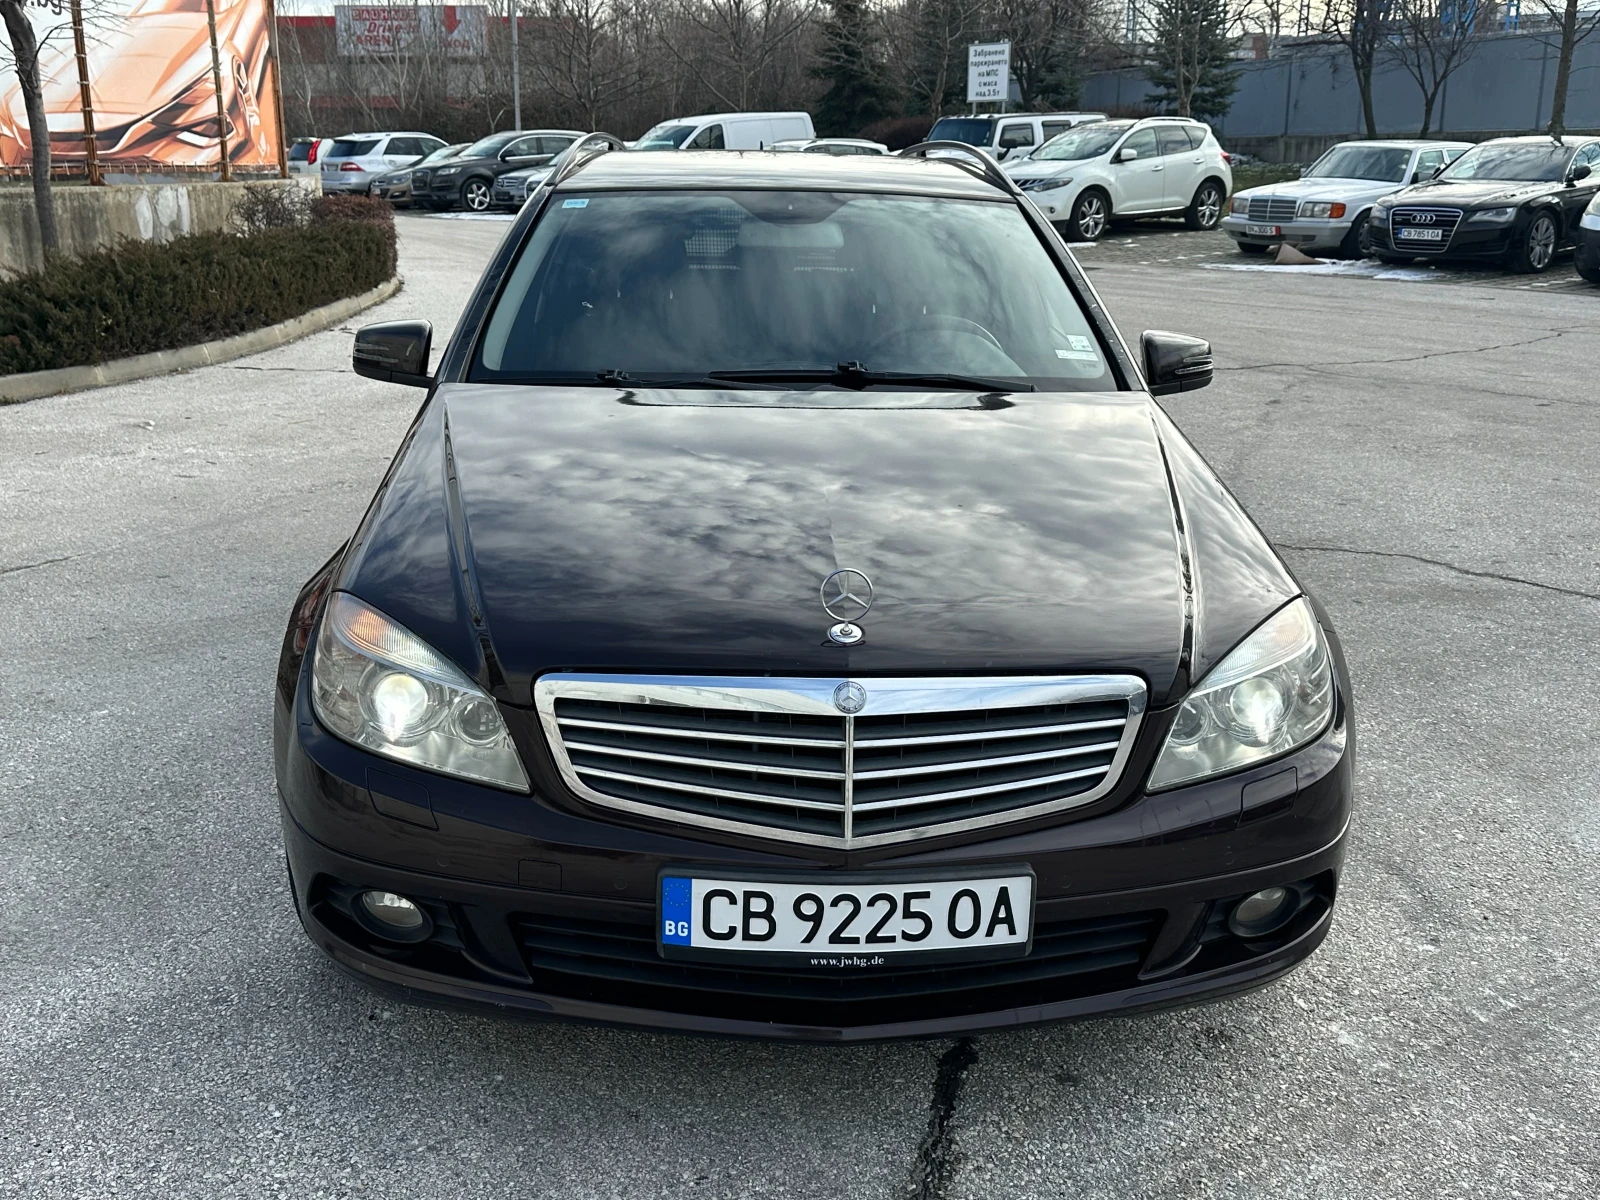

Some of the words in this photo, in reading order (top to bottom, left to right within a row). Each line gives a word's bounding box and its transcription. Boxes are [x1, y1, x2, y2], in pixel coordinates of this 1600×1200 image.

[973, 49, 1006, 57] Забранено
[970, 59, 1008, 67] паркирането
[986, 69, 999, 77] МПС
[702, 888, 777, 942] CB
[792, 890, 933, 945] 9225
[946, 885, 1017, 940] OA
[665, 920, 689, 937] BG
[810, 955, 885, 968] www.jwhg.de
